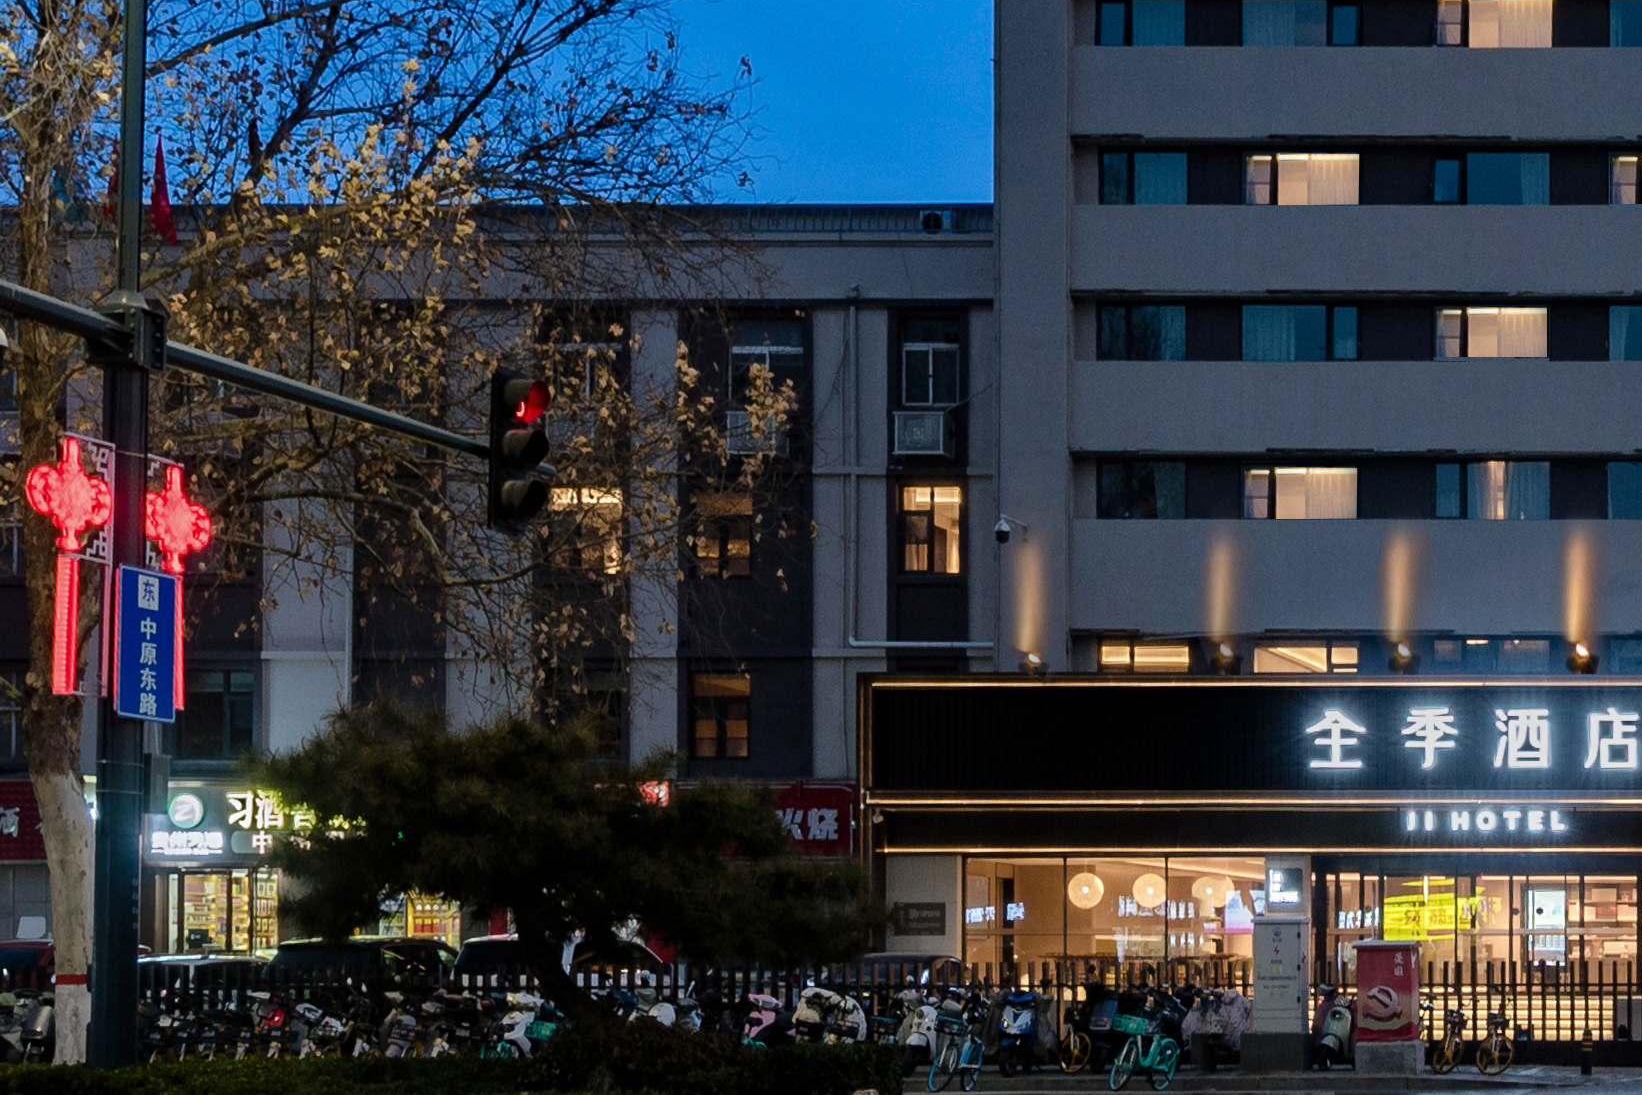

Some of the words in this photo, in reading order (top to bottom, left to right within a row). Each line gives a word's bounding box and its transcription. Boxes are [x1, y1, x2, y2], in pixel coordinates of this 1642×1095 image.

[142, 579, 155, 603] 东
[139, 617, 157, 716] 中原东路
[1306, 707, 1640, 770] 全季酒店
[1450, 810, 1569, 832] HOTEL
